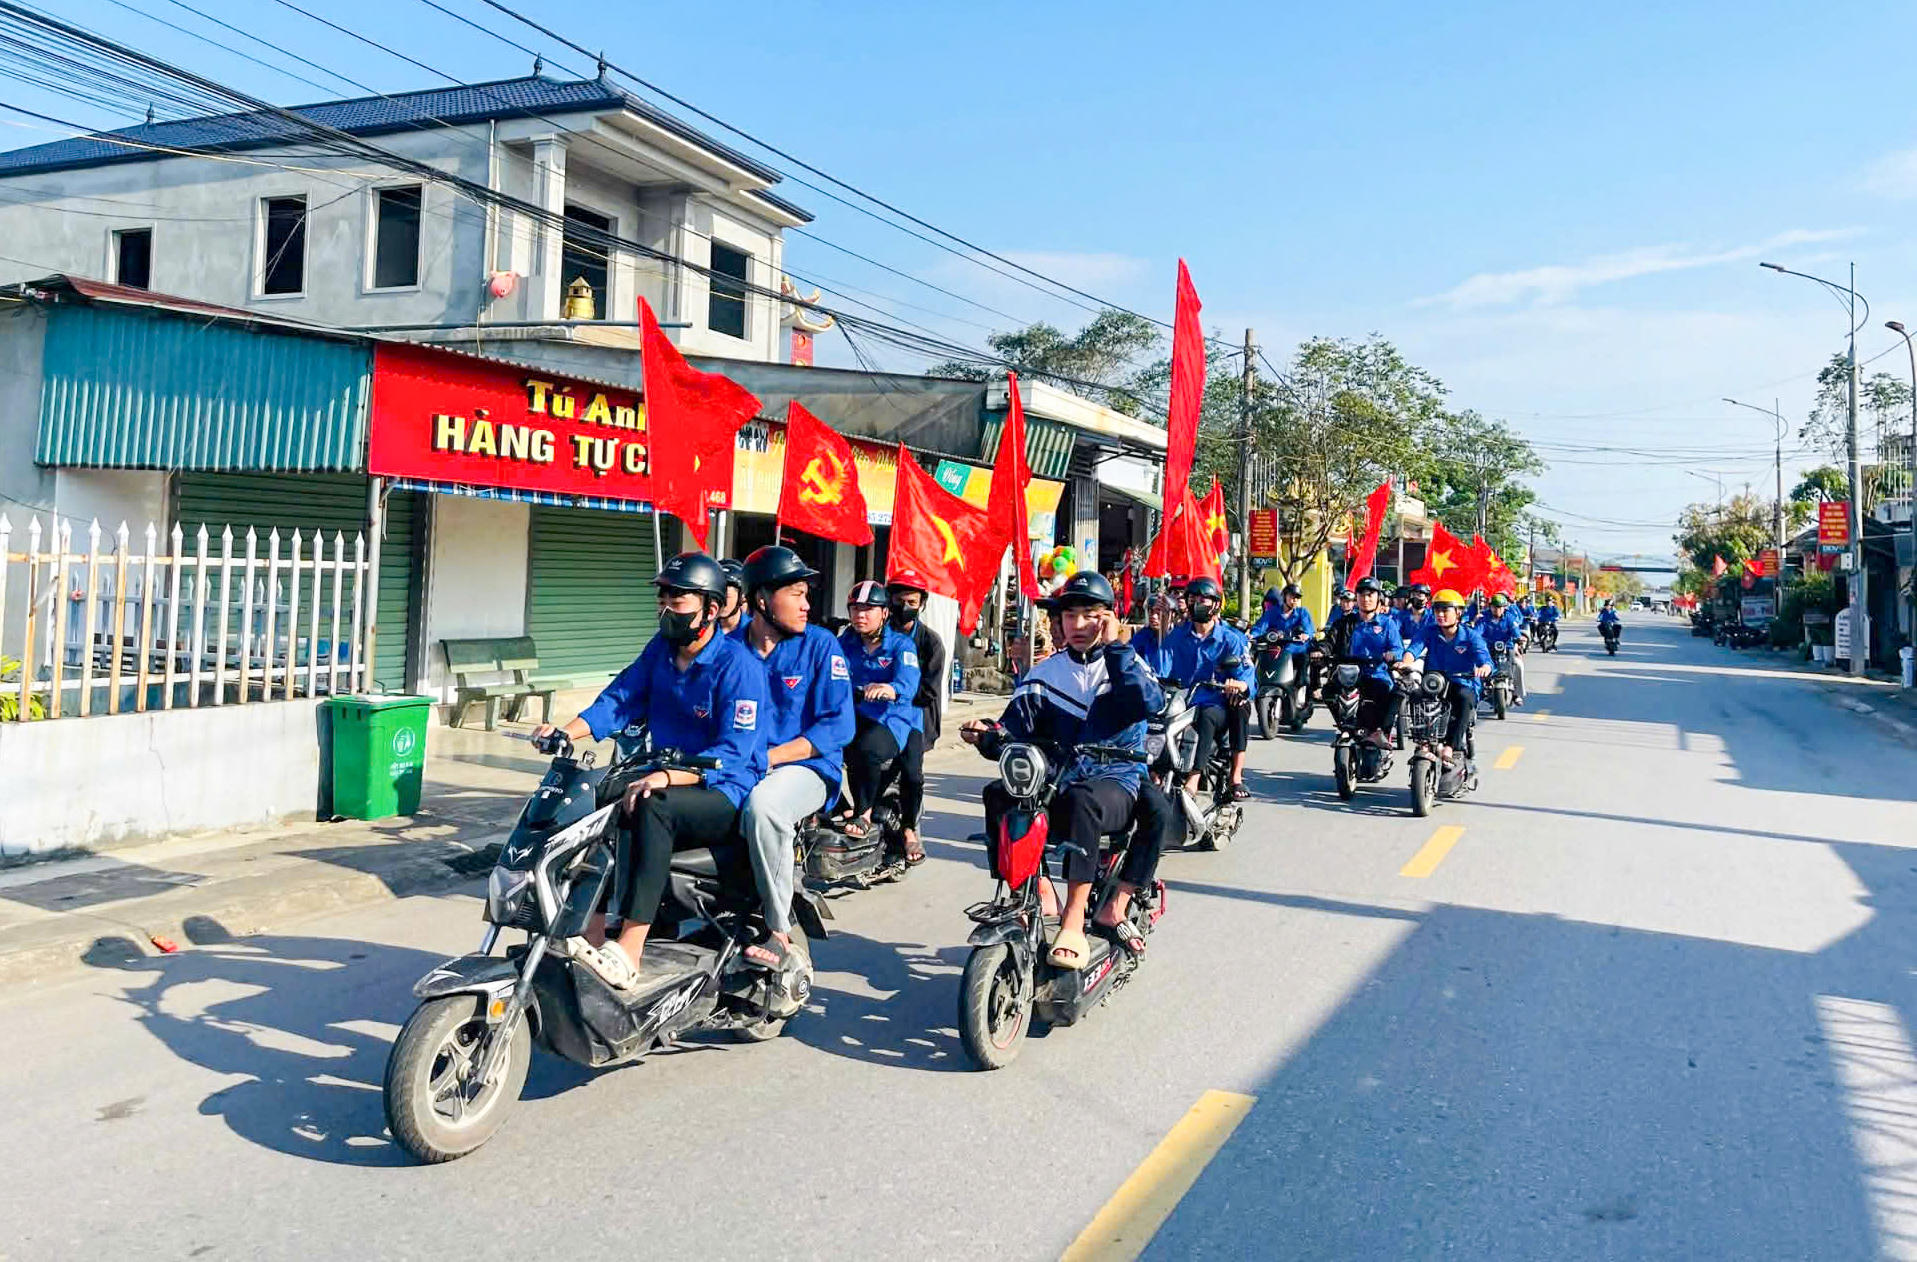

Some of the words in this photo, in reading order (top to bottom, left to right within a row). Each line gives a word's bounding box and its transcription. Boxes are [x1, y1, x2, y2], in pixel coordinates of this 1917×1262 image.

[526, 379, 575, 418] Tú
[433, 408, 555, 463] HÀNG
[572, 434, 619, 477] TỰ
